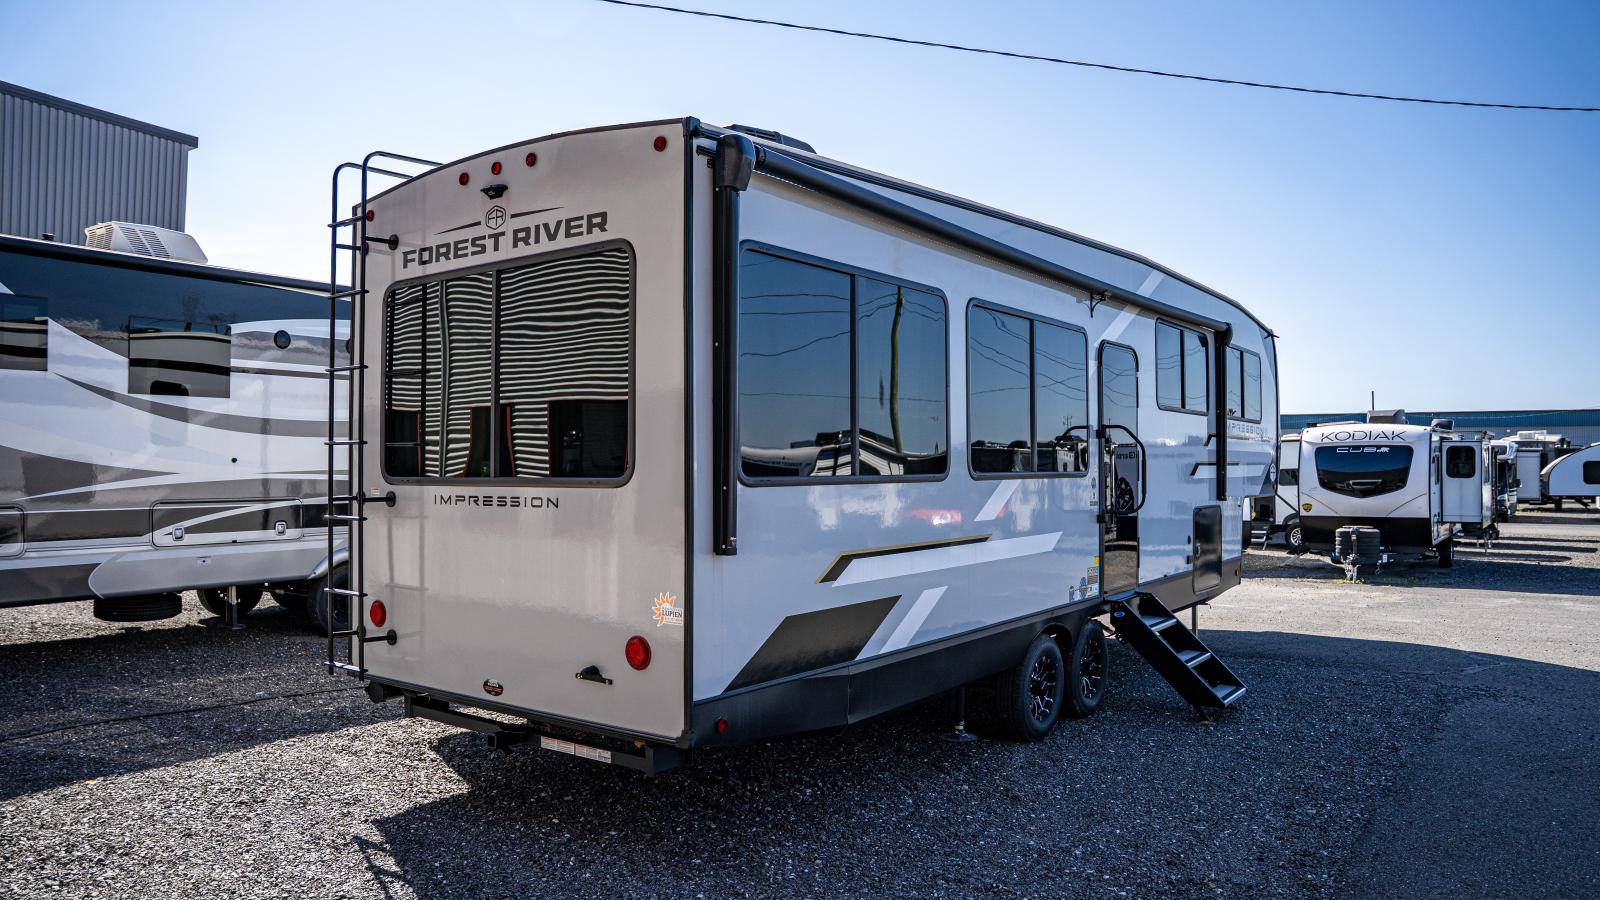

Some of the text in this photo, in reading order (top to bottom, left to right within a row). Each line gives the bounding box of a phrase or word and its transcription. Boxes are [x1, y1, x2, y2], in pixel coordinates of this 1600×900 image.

[402, 211, 608, 269] FOREST RIVER
[1321, 430, 1408, 442] KODIAK
[434, 494, 559, 509] IMPRESSION
